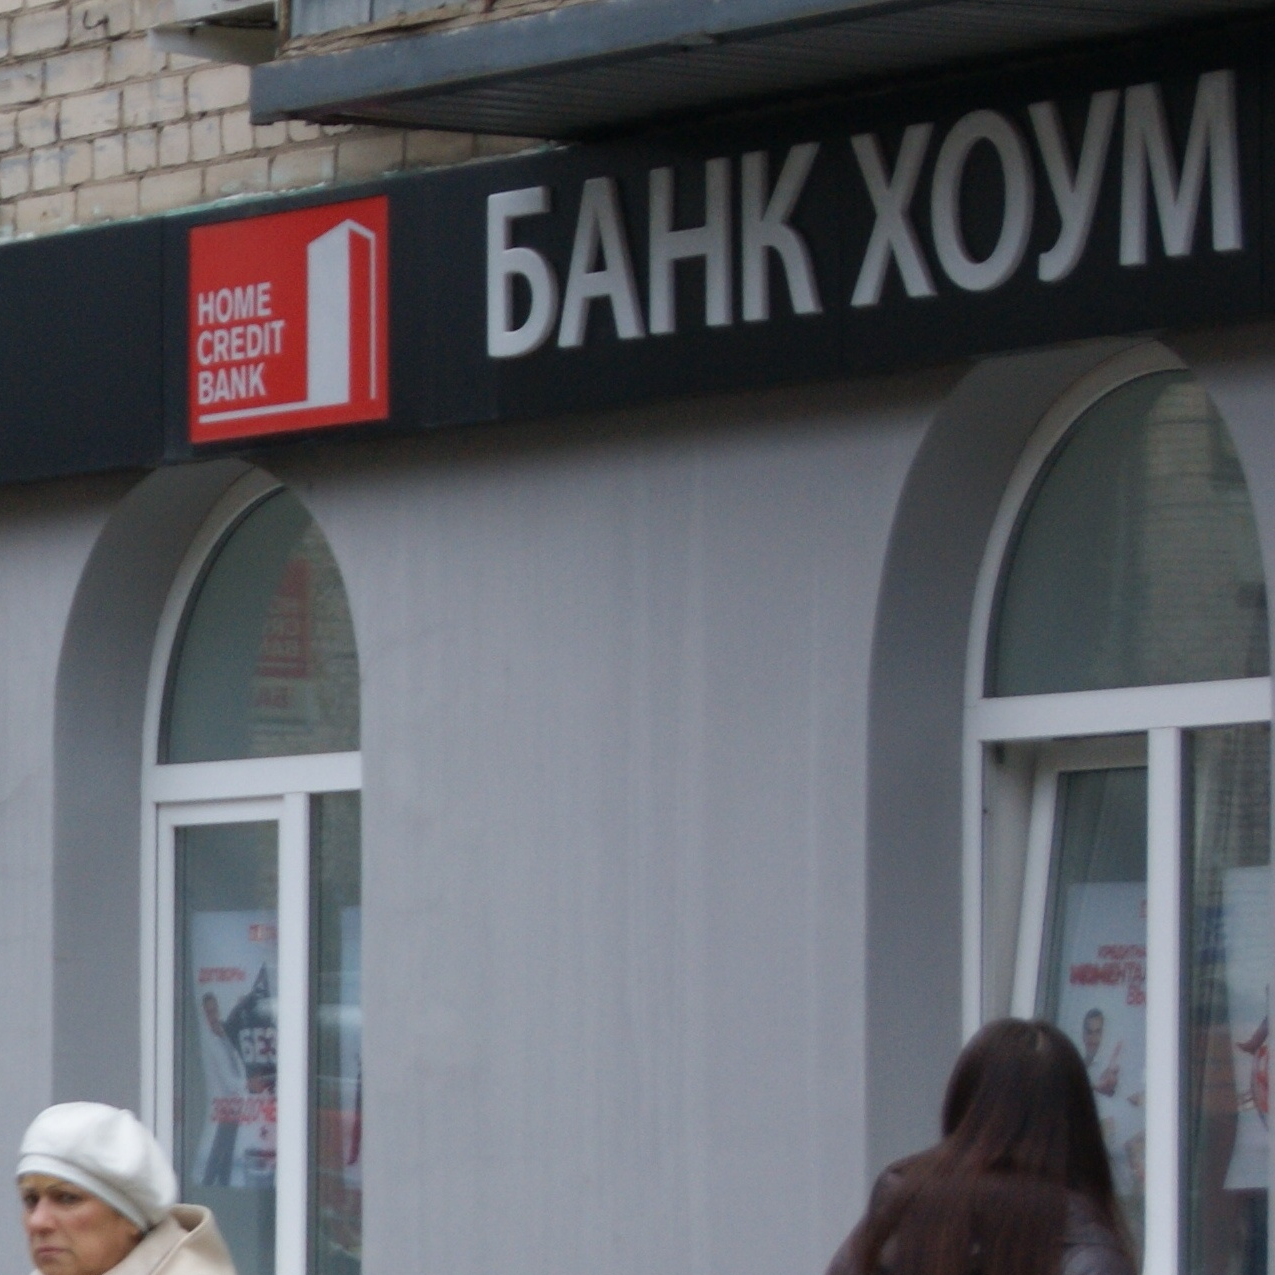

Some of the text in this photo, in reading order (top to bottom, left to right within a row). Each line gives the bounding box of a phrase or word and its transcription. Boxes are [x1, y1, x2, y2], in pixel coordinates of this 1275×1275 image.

[486, 68, 1244, 358] БАНК ХОУМ
[197, 281, 272, 326] HOME
[197, 319, 286, 366] CREDIT
[197, 362, 266, 405] BANK
